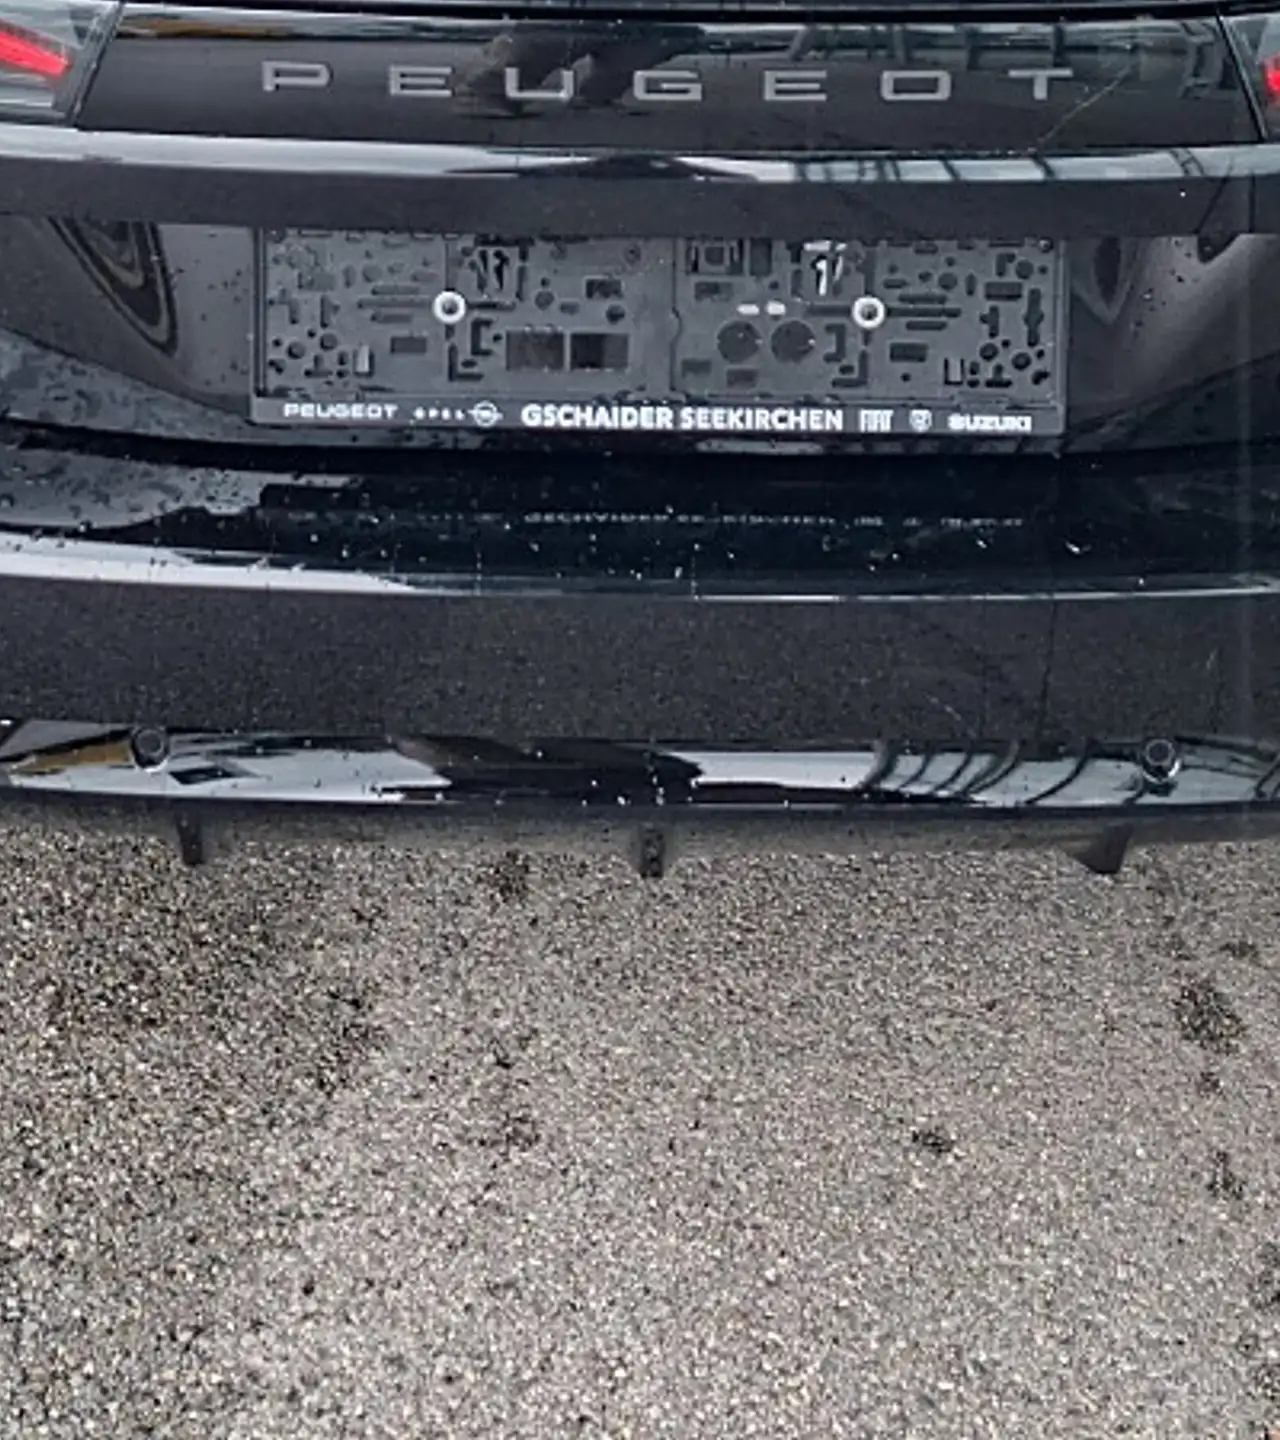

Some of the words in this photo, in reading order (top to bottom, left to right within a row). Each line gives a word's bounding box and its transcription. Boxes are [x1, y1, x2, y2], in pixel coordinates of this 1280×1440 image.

[261, 59, 1074, 102] PEUGEOT
[283, 402, 399, 420] PEUGEOT
[520, 402, 673, 430] GSCHAIDER
[679, 405, 844, 432] SEEKIRCHEN
[859, 409, 894, 433] FIAT
[947, 413, 1032, 433] SUZUKI
